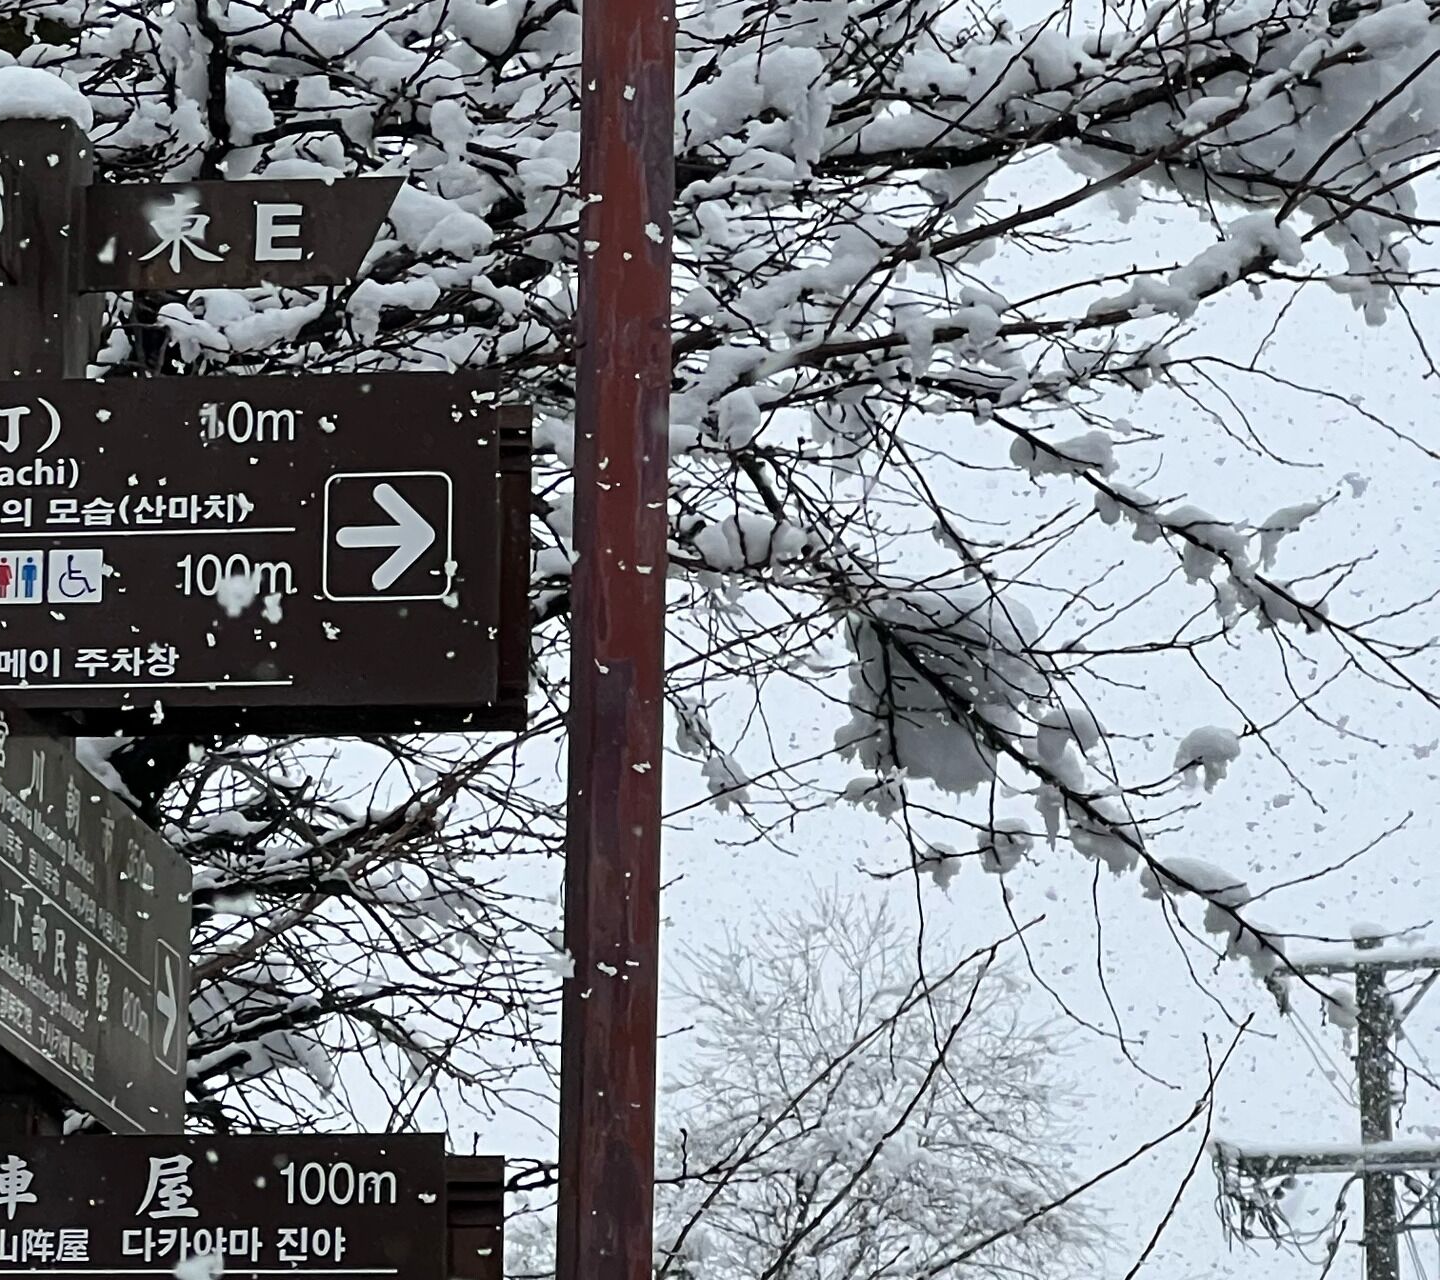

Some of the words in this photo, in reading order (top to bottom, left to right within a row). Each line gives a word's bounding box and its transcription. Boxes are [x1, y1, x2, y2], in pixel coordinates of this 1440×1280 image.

[137, 191, 225, 274] 東
[253, 202, 304, 262] E
[46, 493, 252, 526] 모습(산마치)
[176, 553, 294, 597] 100m
[74, 645, 179, 677] 주차장
[280, 1161, 396, 1206] 100m
[122, 1227, 262, 1263] 다카야마
[276, 1227, 346, 1263] 진야
